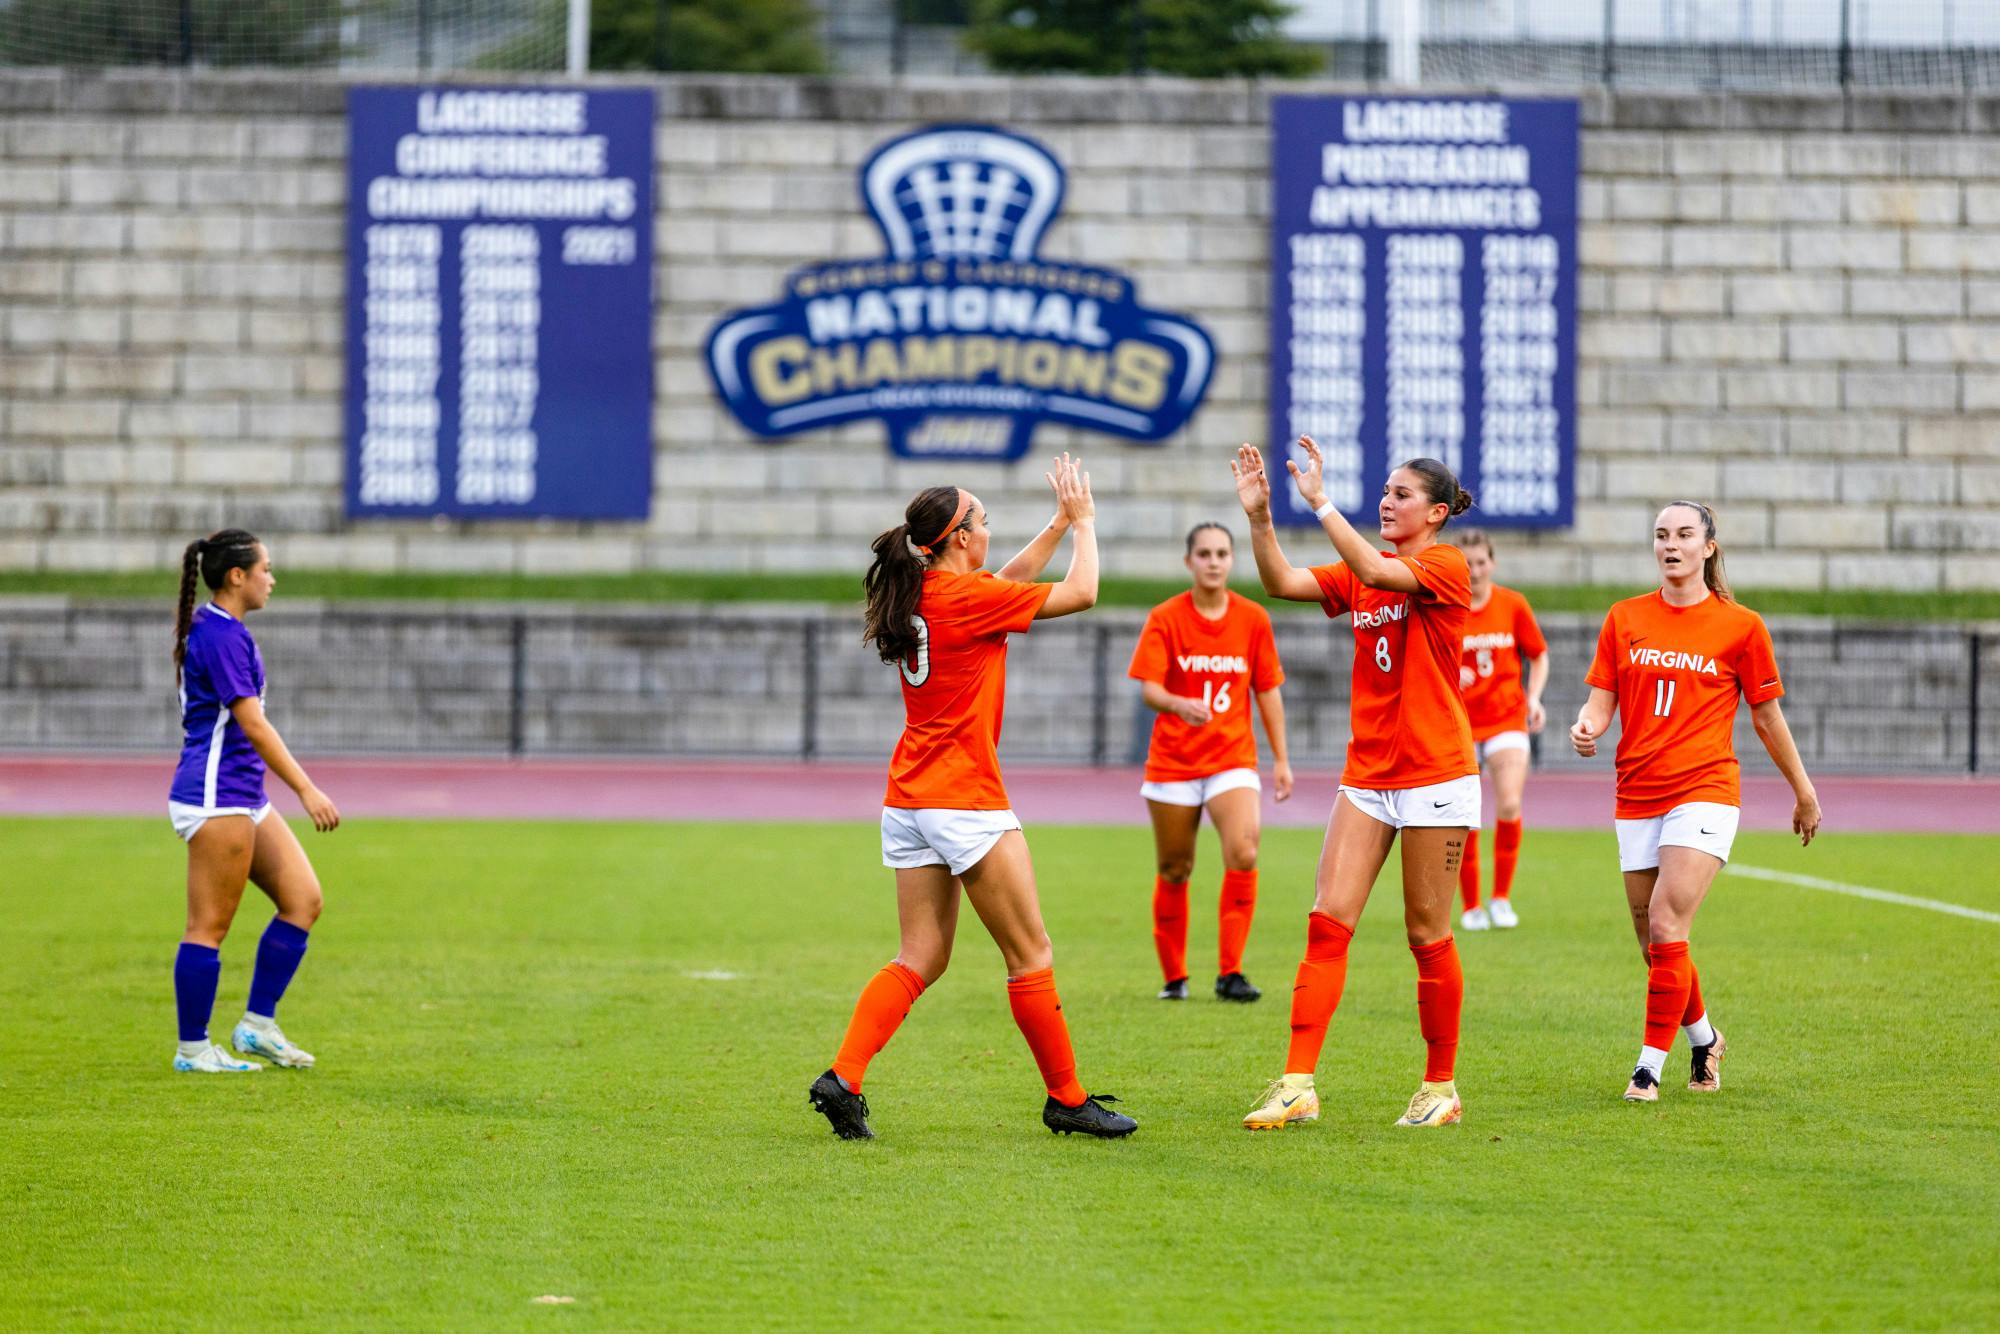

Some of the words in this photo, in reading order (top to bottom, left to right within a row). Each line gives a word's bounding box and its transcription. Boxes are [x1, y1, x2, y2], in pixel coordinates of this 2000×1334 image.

[417, 92, 586, 133] LACROSSE
[1343, 101, 1509, 141] LACROSSE
[396, 135, 606, 175] CONFERENCE
[1322, 143, 1529, 183] POSTSEASON
[367, 177, 635, 219] CHAMPIONSHIPS
[1310, 186, 1540, 227] APPEARANCES
[563, 227, 635, 264] 2021
[805, 287, 1110, 346] NATIONAL
[748, 335, 1174, 410] CHAMPIONS
[904, 415, 1013, 452] JMU
[1375, 635, 1393, 674] 8
[1629, 647, 1718, 676] VIRGINIA
[1202, 680, 1232, 713] 16
[1653, 679, 1677, 717] 11
